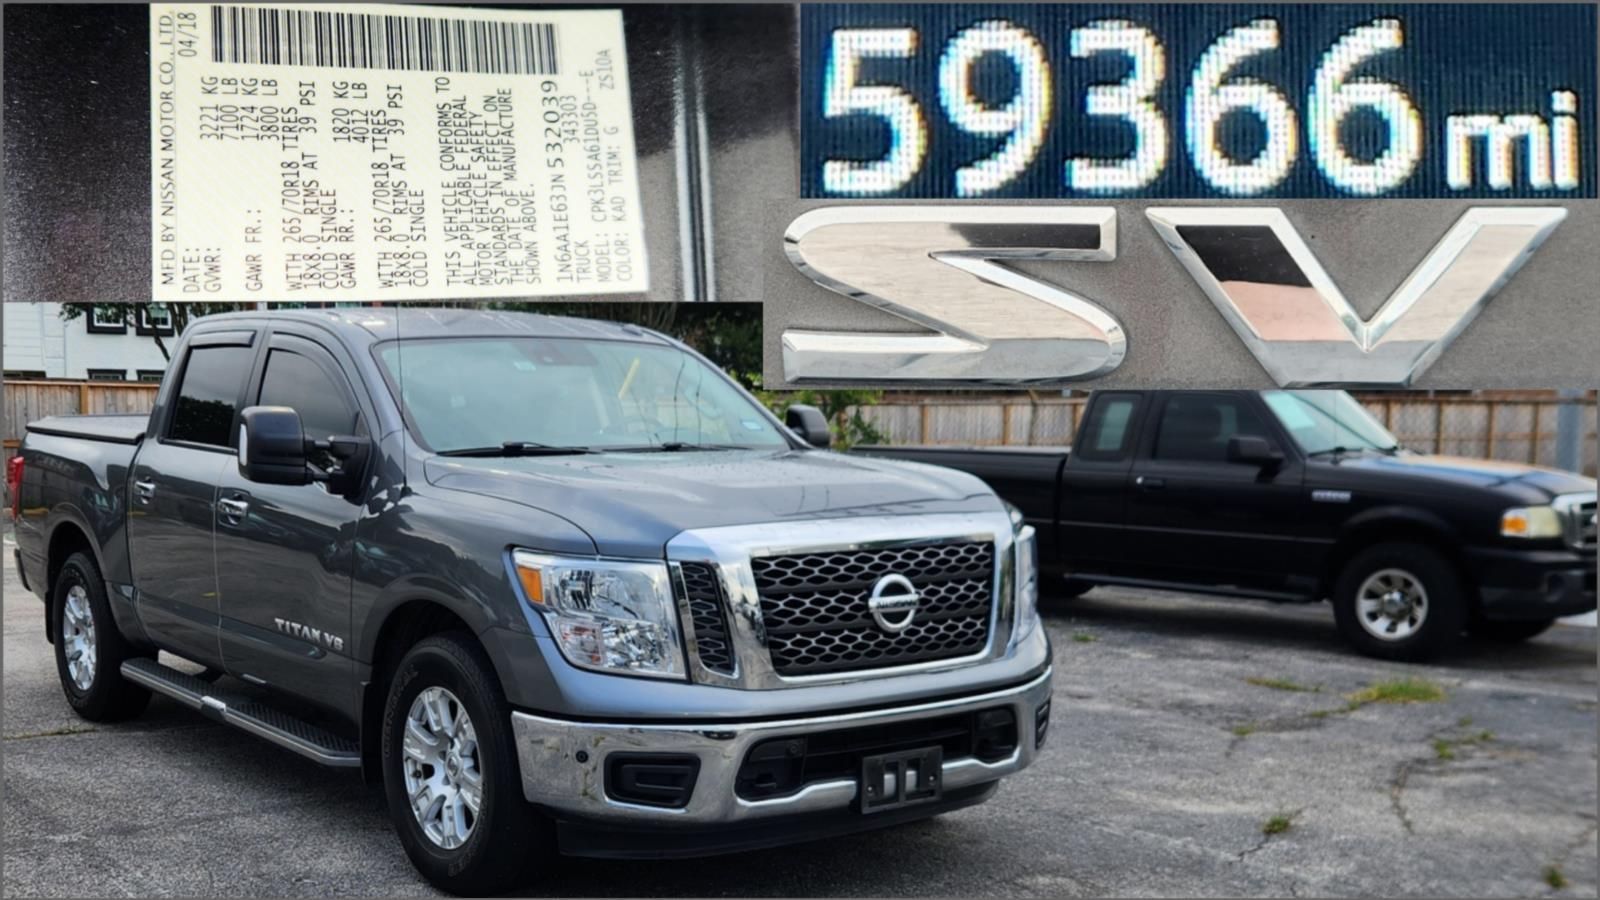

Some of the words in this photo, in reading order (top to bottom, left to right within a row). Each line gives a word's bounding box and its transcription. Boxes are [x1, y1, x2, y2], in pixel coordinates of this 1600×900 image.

[177, 12, 199, 57] 04/18
[201, 76, 218, 94] KG
[222, 77, 238, 95] LB
[242, 78, 258, 95] KG
[262, 79, 277, 96] LB
[299, 81, 315, 105] PSI
[333, 81, 348, 99] KG
[352, 82, 367, 99] LB
[387, 84, 402, 108] PSI
[435, 77, 449, 93] TO
[483, 95, 498, 112] ON
[560, 95, 580, 143] 343303
[822, 18, 1422, 197] 59366
[1446, 89, 1580, 190] mi
[160, 92, 173, 152] MOTOR
[200, 104, 218, 140] 3221
[221, 105, 238, 140] 7100
[241, 106, 259, 141] 1724
[261, 106, 279, 141] 3800
[281, 107, 298, 151] TIRES
[299, 116, 317, 133] 39
[333, 108, 350, 143] 1820
[352, 110, 368, 143] 4012
[371, 109, 388, 152] TIRES
[388, 119, 404, 135] 39
[438, 102, 455, 171] CONFORMS
[452, 96, 468, 153] FEDERAL
[469, 112, 486, 162] SAFETY
[497, 89, 517, 181] MANUFACTURE
[603, 126, 618, 135] G
[301, 152, 318, 169] AT
[390, 153, 406, 171] AT
[484, 122, 502, 171] EFFECT
[604, 145, 622, 183] TRIM:
[160, 158, 174, 216] NISSAN
[281, 161, 301, 243] 265/70R18
[302, 180, 318, 214] RIMS
[372, 162, 393, 242] 265/70R18
[391, 181, 408, 214] RIMS
[472, 173, 490, 233] VEHICLE
[487, 181, 503, 197] IN
[503, 190, 519, 206] OF
[320, 189, 337, 242] SINGLE
[410, 190, 426, 242] SINGLE
[441, 182, 459, 242] VEHICLE
[456, 164, 475, 250] APPLICABLE
[520, 183, 537, 232] ABOVE.
[608, 196, 625, 222] KAD
[160, 223, 174, 242] BY
[490, 207, 510, 285] STANDARDS
[507, 217, 522, 249] DATE
[161, 249, 175, 285] MFD
[183, 247, 200, 293] DATE:
[204, 247, 222, 293] GVWR:
[245, 254, 263, 291] GAWR
[286, 254, 301, 291] WITH
[323, 253, 338, 289] COLD
[339, 253, 356, 289] GAWR
[378, 252, 393, 288] WITH
[412, 251, 428, 287] COLD
[445, 251, 461, 286] THIS
[461, 261, 477, 285] ALL
[477, 242, 493, 286] MOTOR
[510, 261, 524, 284] THE
[524, 241, 541, 284] SHOWN
[575, 241, 591, 283] TRUCK
[592, 233, 611, 282] MODEL:
[612, 232, 632, 281] COLOR:
[783, 206, 1569, 386] SV
[275, 618, 320, 642] TITAN
